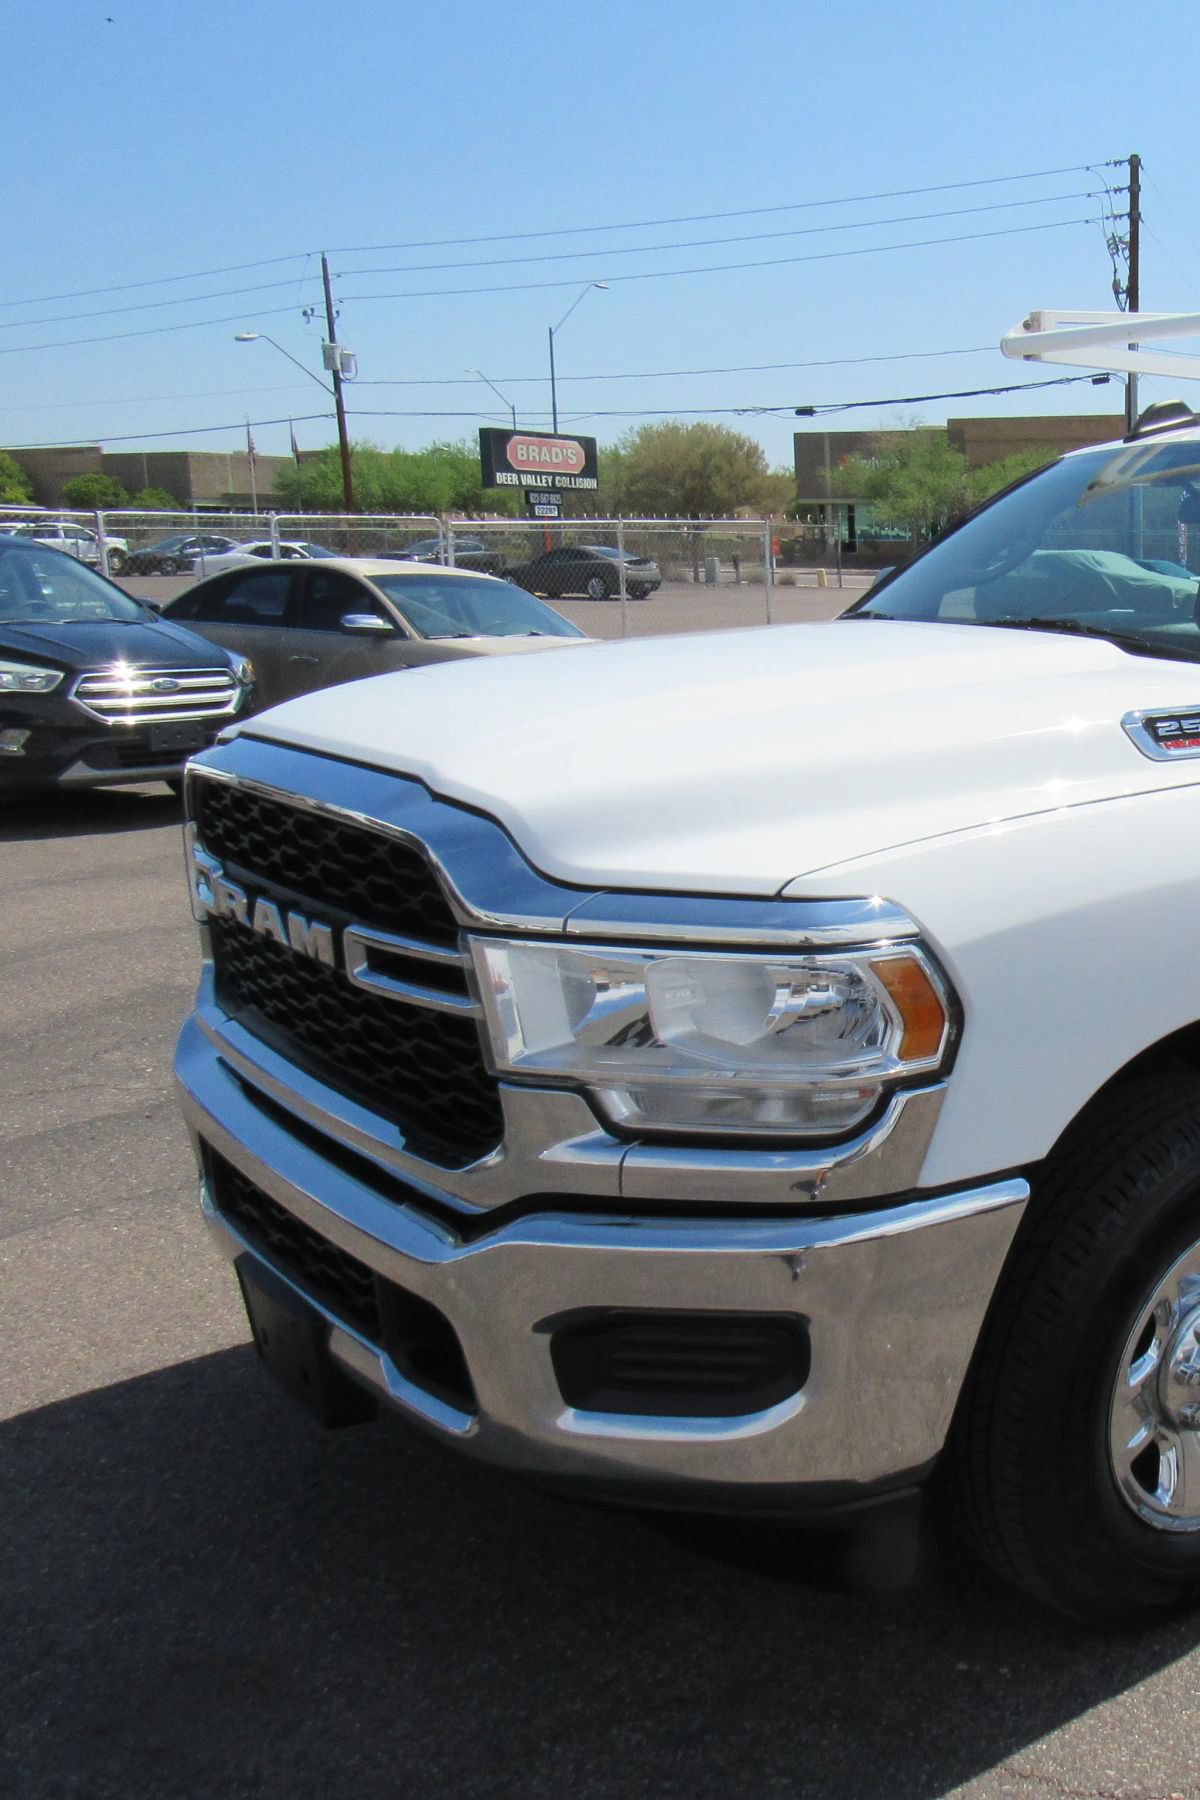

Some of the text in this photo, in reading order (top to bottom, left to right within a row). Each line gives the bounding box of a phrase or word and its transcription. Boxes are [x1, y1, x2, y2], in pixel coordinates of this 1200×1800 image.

[516, 444, 577, 465] BRAD'S
[496, 472, 597, 489] DEER VALLEY COLLISION
[213, 877, 336, 968] RAM
